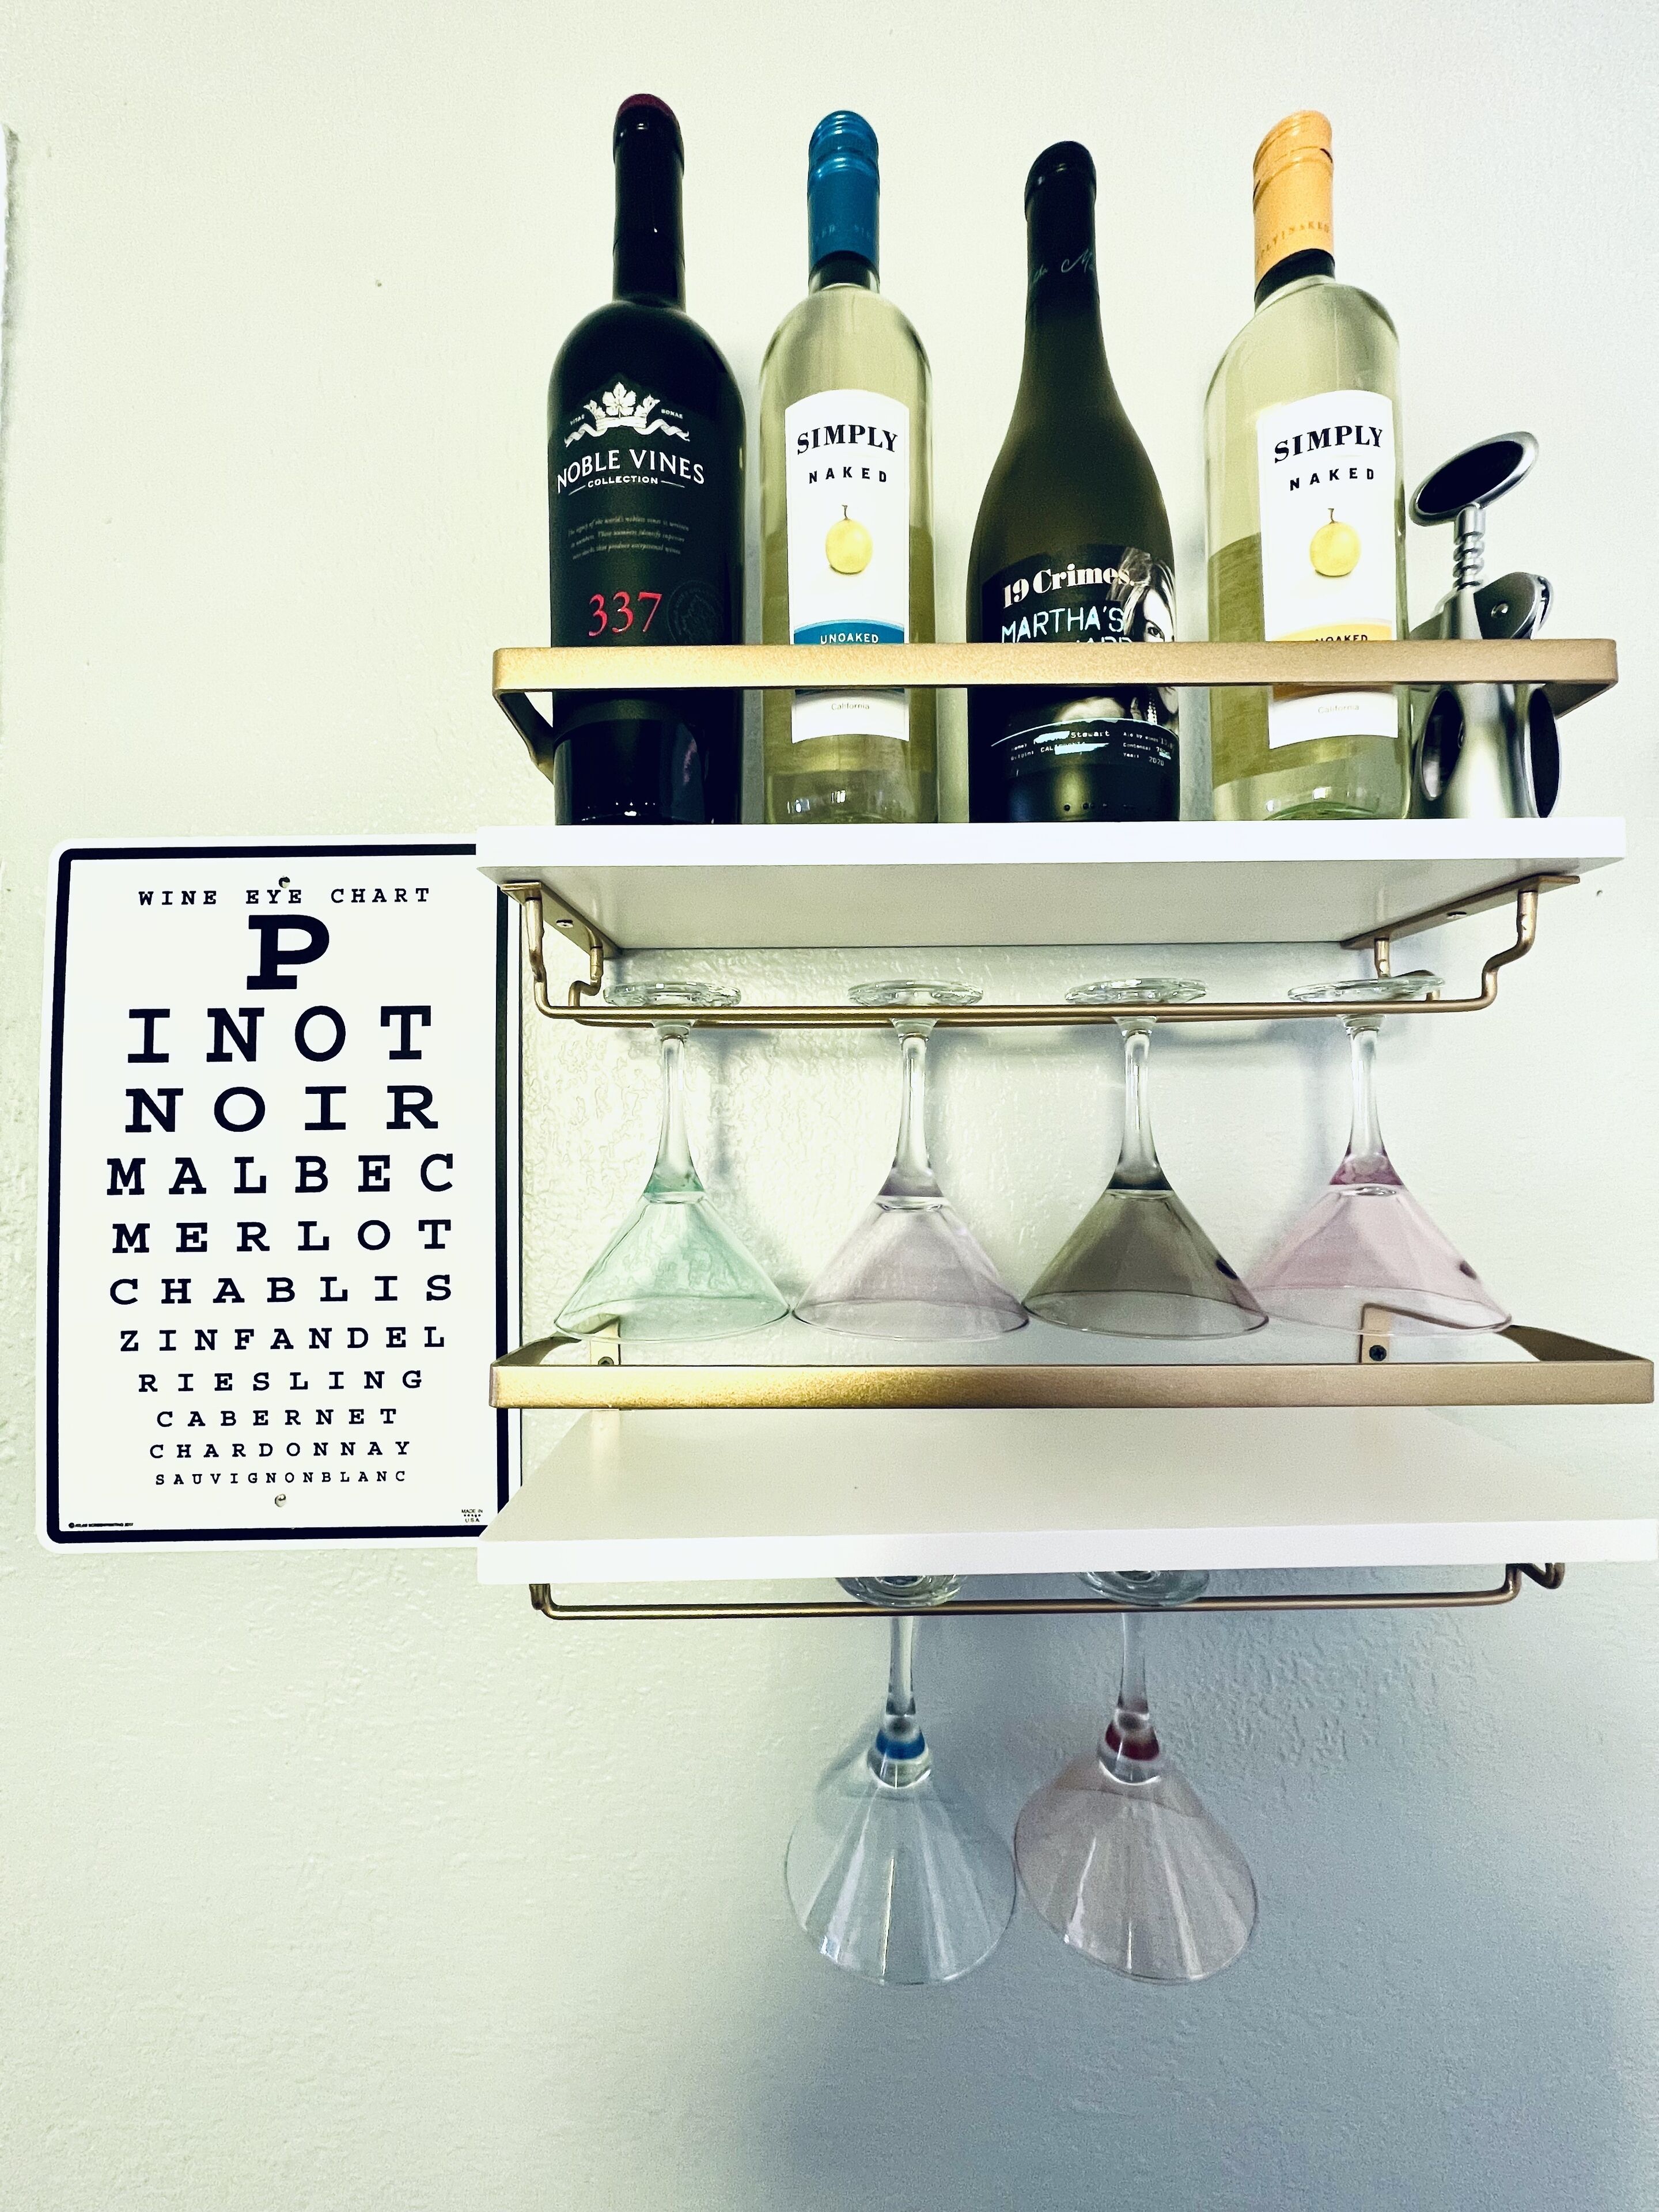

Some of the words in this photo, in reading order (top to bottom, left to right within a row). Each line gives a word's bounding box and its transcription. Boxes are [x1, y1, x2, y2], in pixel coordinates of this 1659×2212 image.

[797, 424, 898, 455] SIMPLY
[1274, 425, 1382, 463] SIMPLY
[557, 449, 620, 494] NOBLE
[629, 449, 704, 484] VINES
[588, 475, 658, 488] COLLECTION
[809, 466, 887, 484] NAKED
[1290, 467, 1374, 491] NAKED
[1003, 578, 1029, 608] 19
[1032, 563, 1131, 594] Crimes
[588, 590, 663, 637] 337
[1002, 605, 1124, 643] MARTHA'S
[820, 632, 879, 645] UNOAKED
[1071, 730, 1110, 738] Stewart
[139, 891, 216, 905] WINE
[246, 890, 301, 904] EYE
[331, 888, 429, 903] CHART
[247, 915, 329, 990] P
[128, 1006, 431, 1063] INOT
[126, 1085, 438, 1132] NOIR
[107, 1154, 453, 1195] MALBEC
[112, 1219, 451, 1253] MERLOT
[110, 1275, 451, 1305] CHABLIS
[121, 1327, 444, 1351] ZINFANDEL
[139, 1370, 421, 1392] RIESLING
[157, 1409, 396, 1427] CABERNET
[150, 1442, 410, 1458] CHARDONNAY
[156, 1471, 404, 1484] SAUVIGNONBLANC
